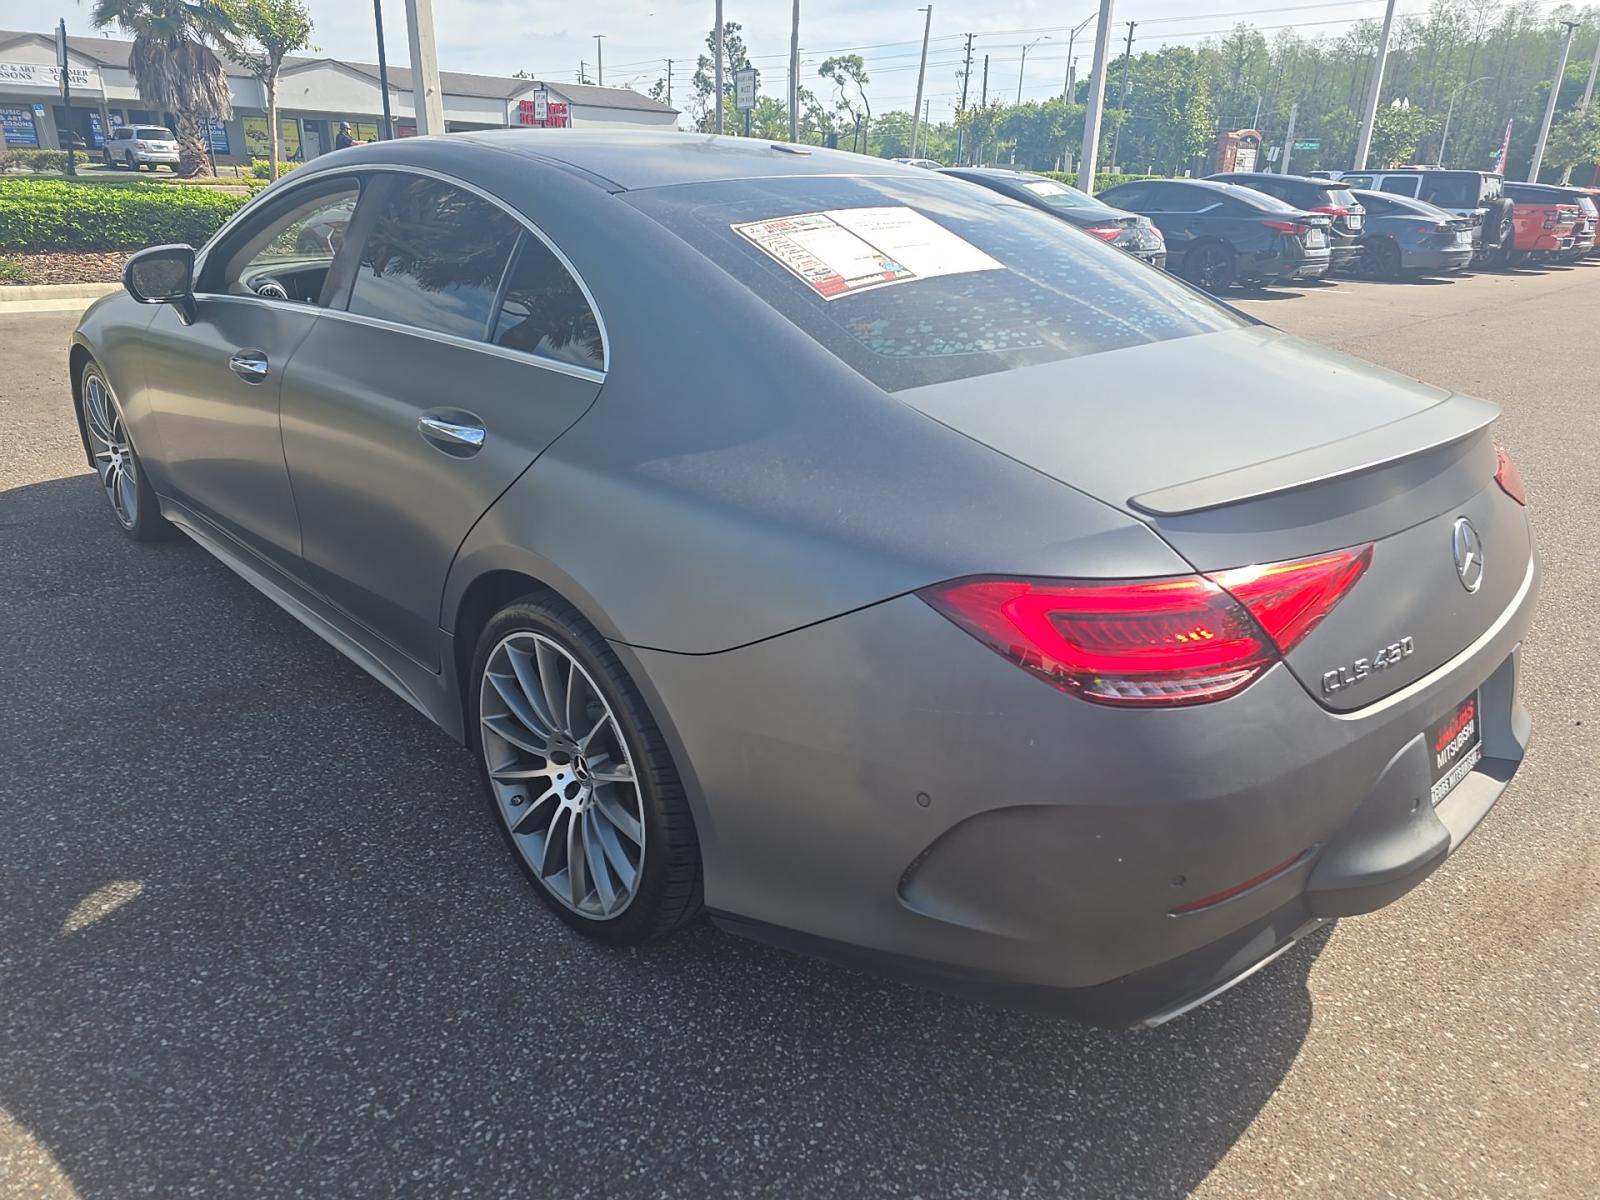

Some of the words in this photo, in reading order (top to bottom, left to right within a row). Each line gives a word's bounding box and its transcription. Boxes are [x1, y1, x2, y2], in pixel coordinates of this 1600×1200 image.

[19, 65, 36, 73] ART
[48, 66, 89, 77] SUMER
[53, 74, 88, 84] CMPS
[1322, 657, 1370, 694] CLS
[1372, 635, 1414, 670] 450
[1436, 718, 1476, 769] MITSUBISHI
